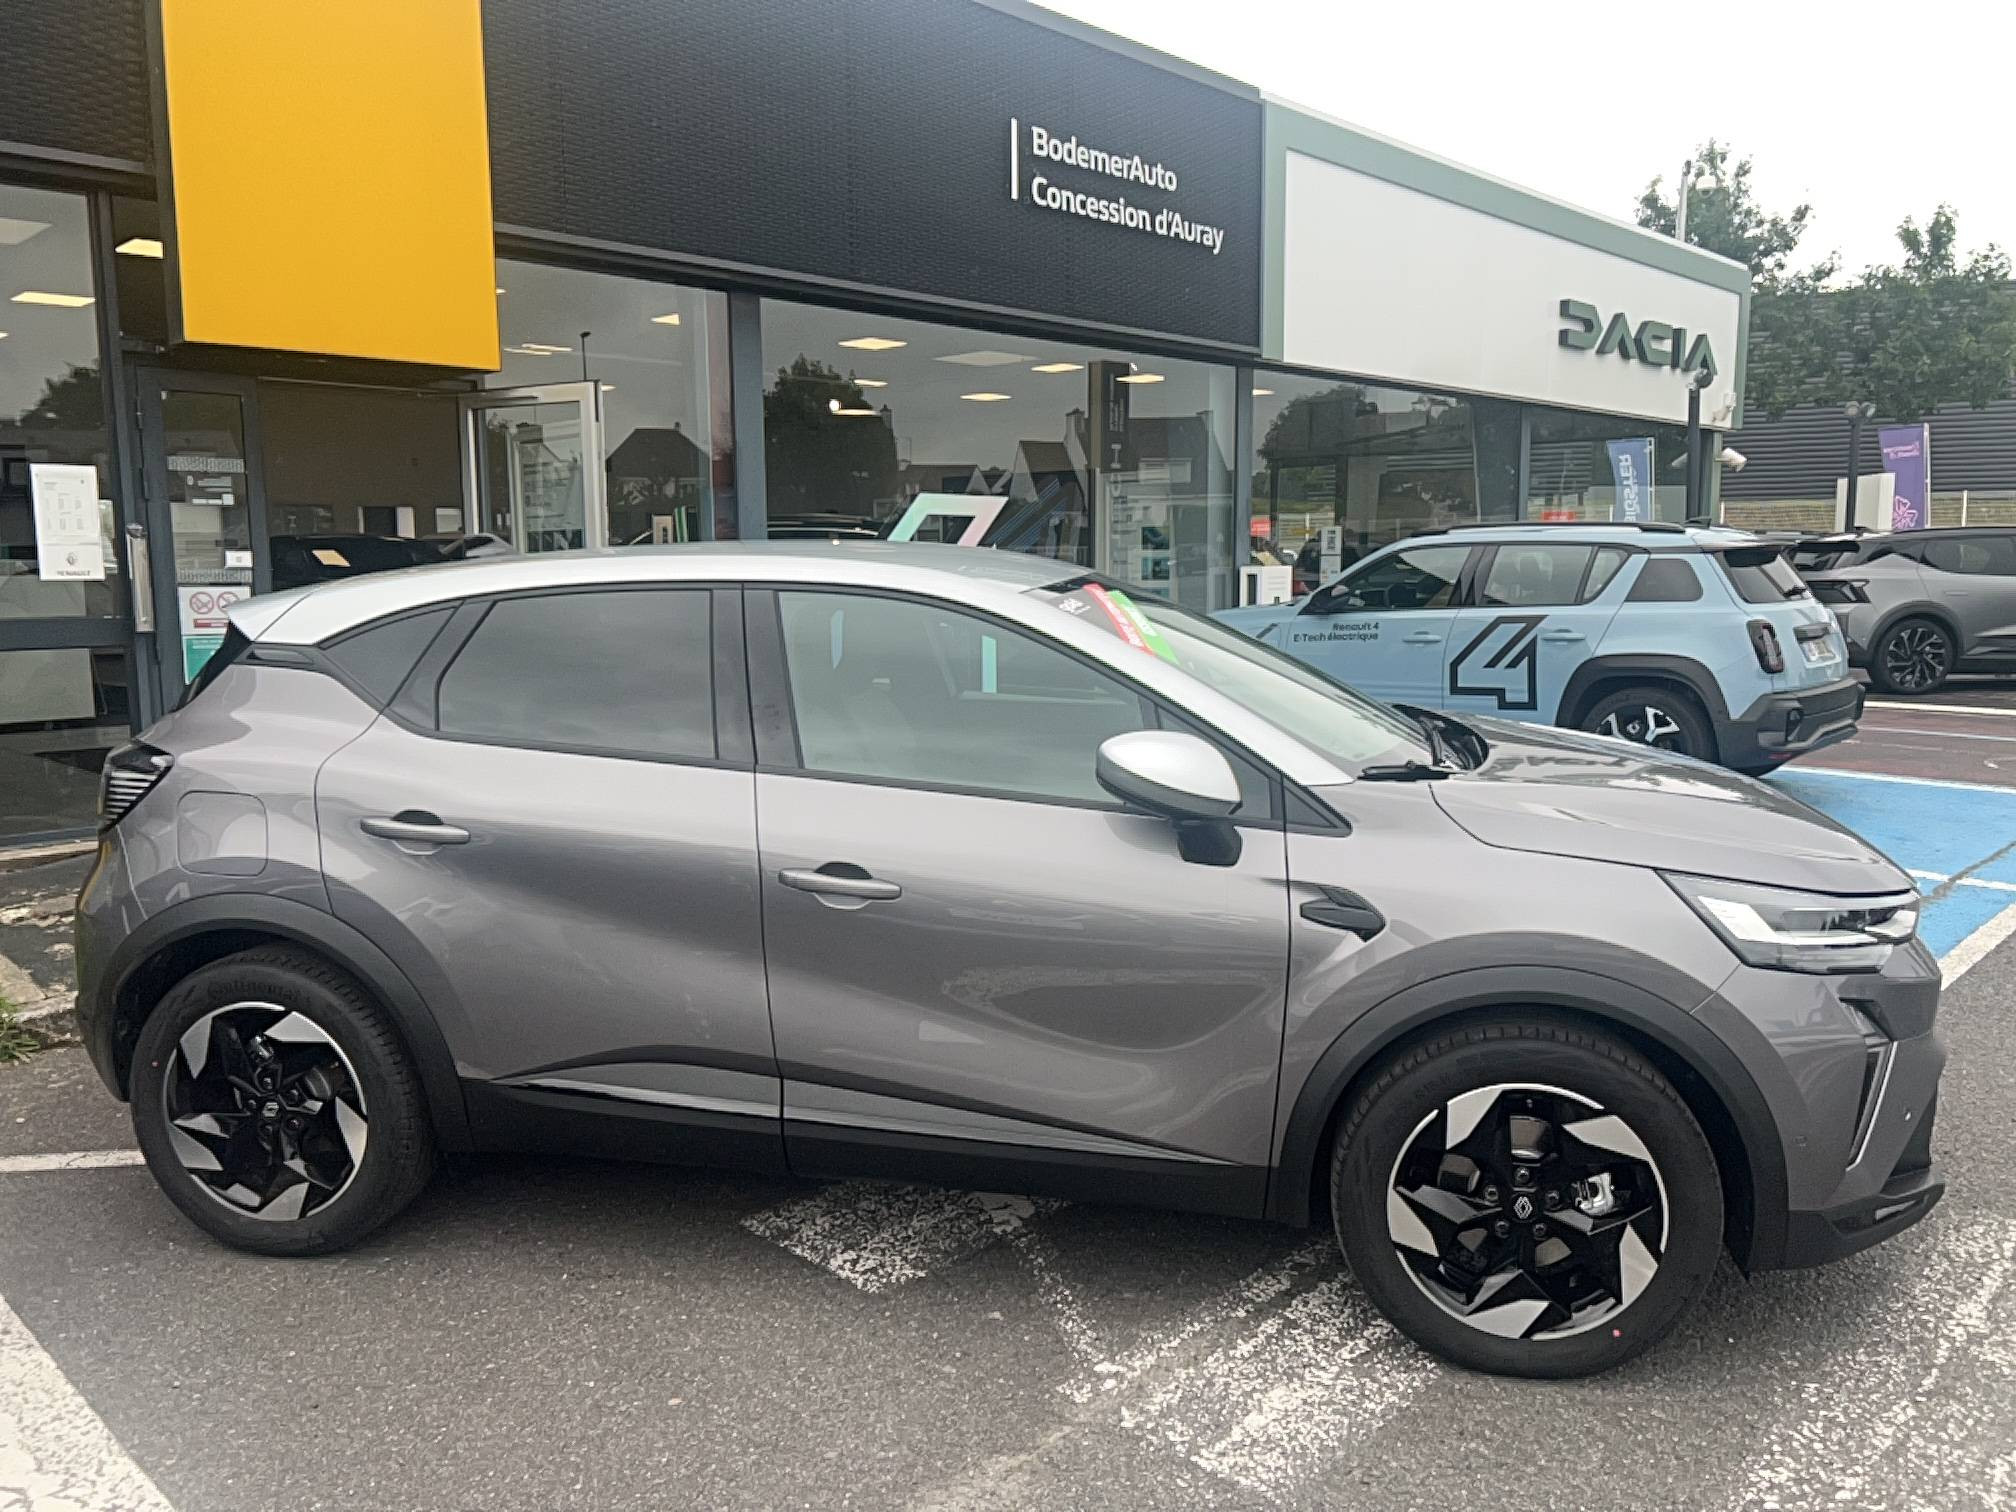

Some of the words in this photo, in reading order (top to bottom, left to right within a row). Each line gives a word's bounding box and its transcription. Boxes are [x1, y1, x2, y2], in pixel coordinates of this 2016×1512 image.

[1031, 126, 1178, 192] BodemerAuto
[1031, 176, 1151, 232] Concession
[1155, 208, 1224, 255] d'Auray
[1558, 298, 1718, 377] DACIA
[1332, 622, 1371, 632] Renault
